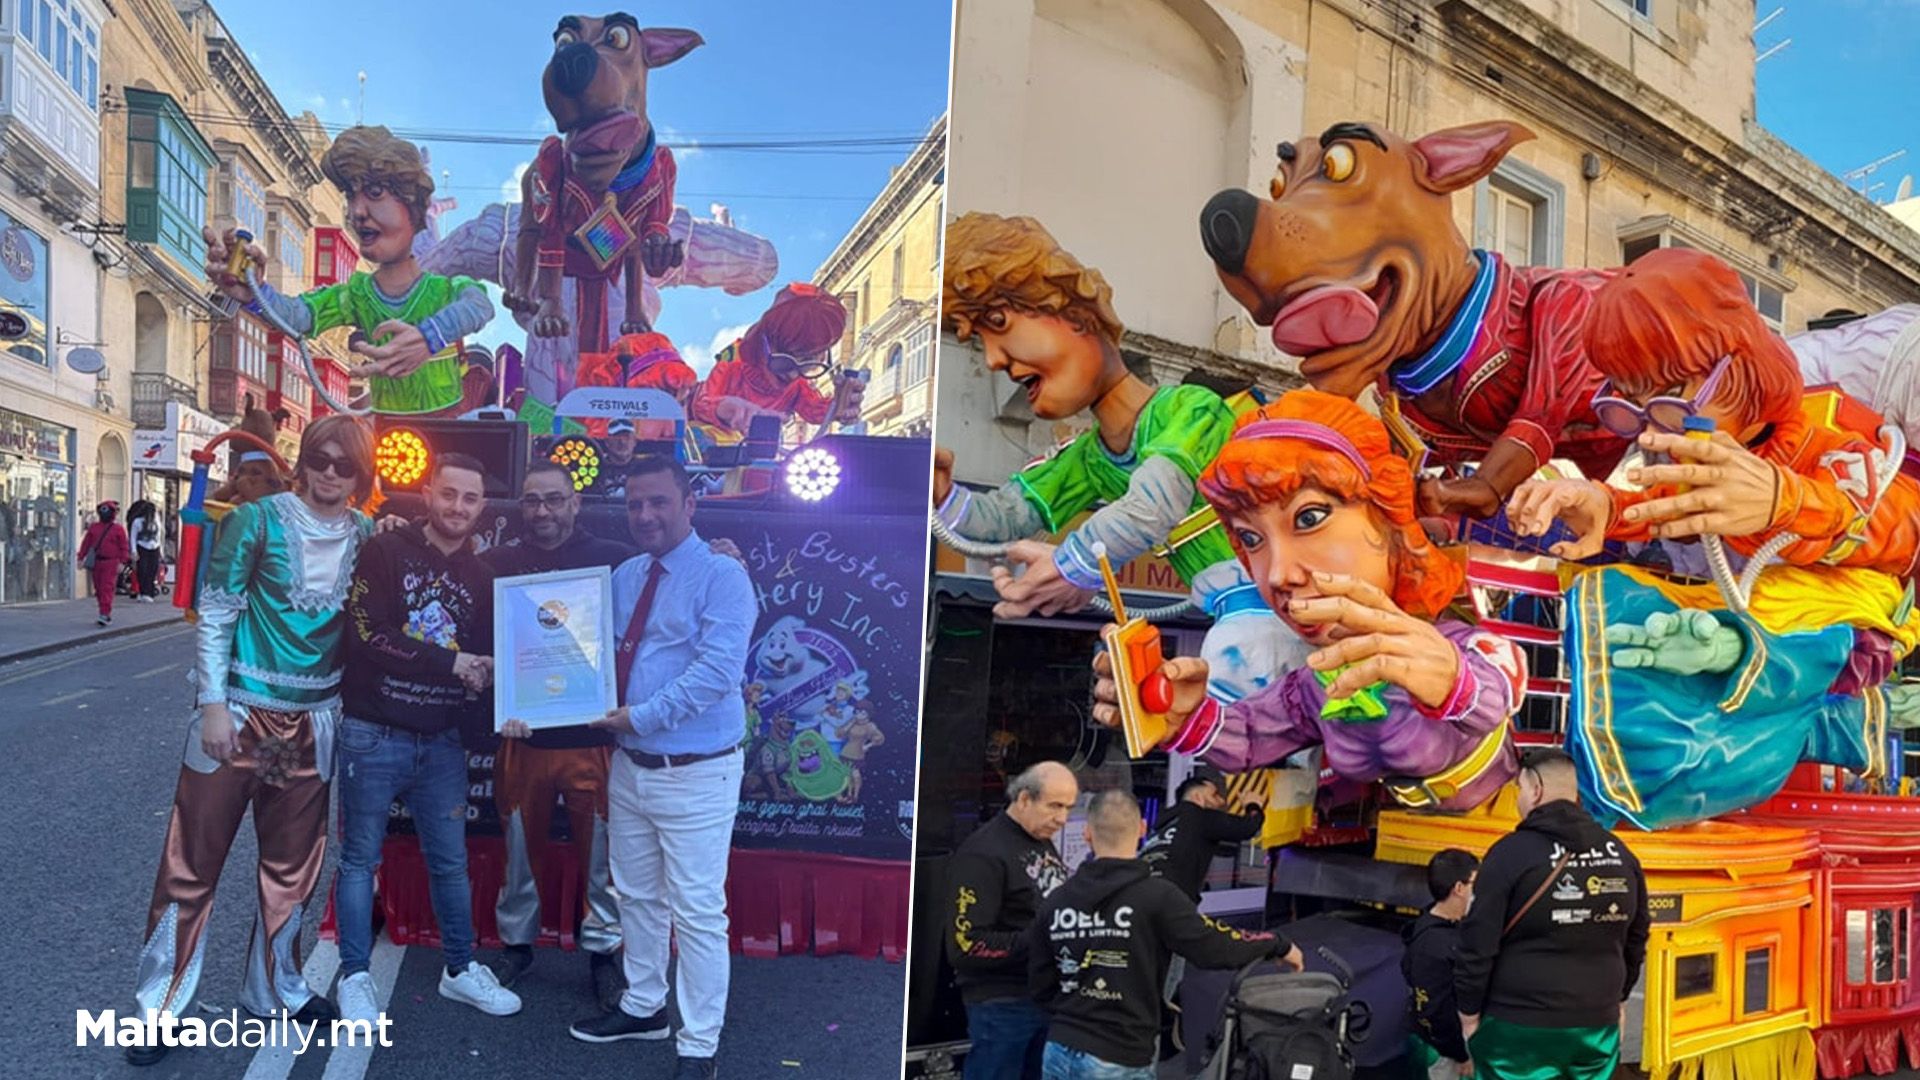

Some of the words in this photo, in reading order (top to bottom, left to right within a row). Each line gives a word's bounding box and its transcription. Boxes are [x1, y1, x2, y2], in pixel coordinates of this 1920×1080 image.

[589, 399, 649, 411] FESTIVALS
[750, 531, 780, 571] st
[775, 548, 803, 579] &
[800, 531, 911, 608] Busters
[755, 580, 824, 616] tery
[1605, 841, 1620, 857] C
[1049, 907, 1106, 931] JOEL
[1114, 906, 1134, 928] C
